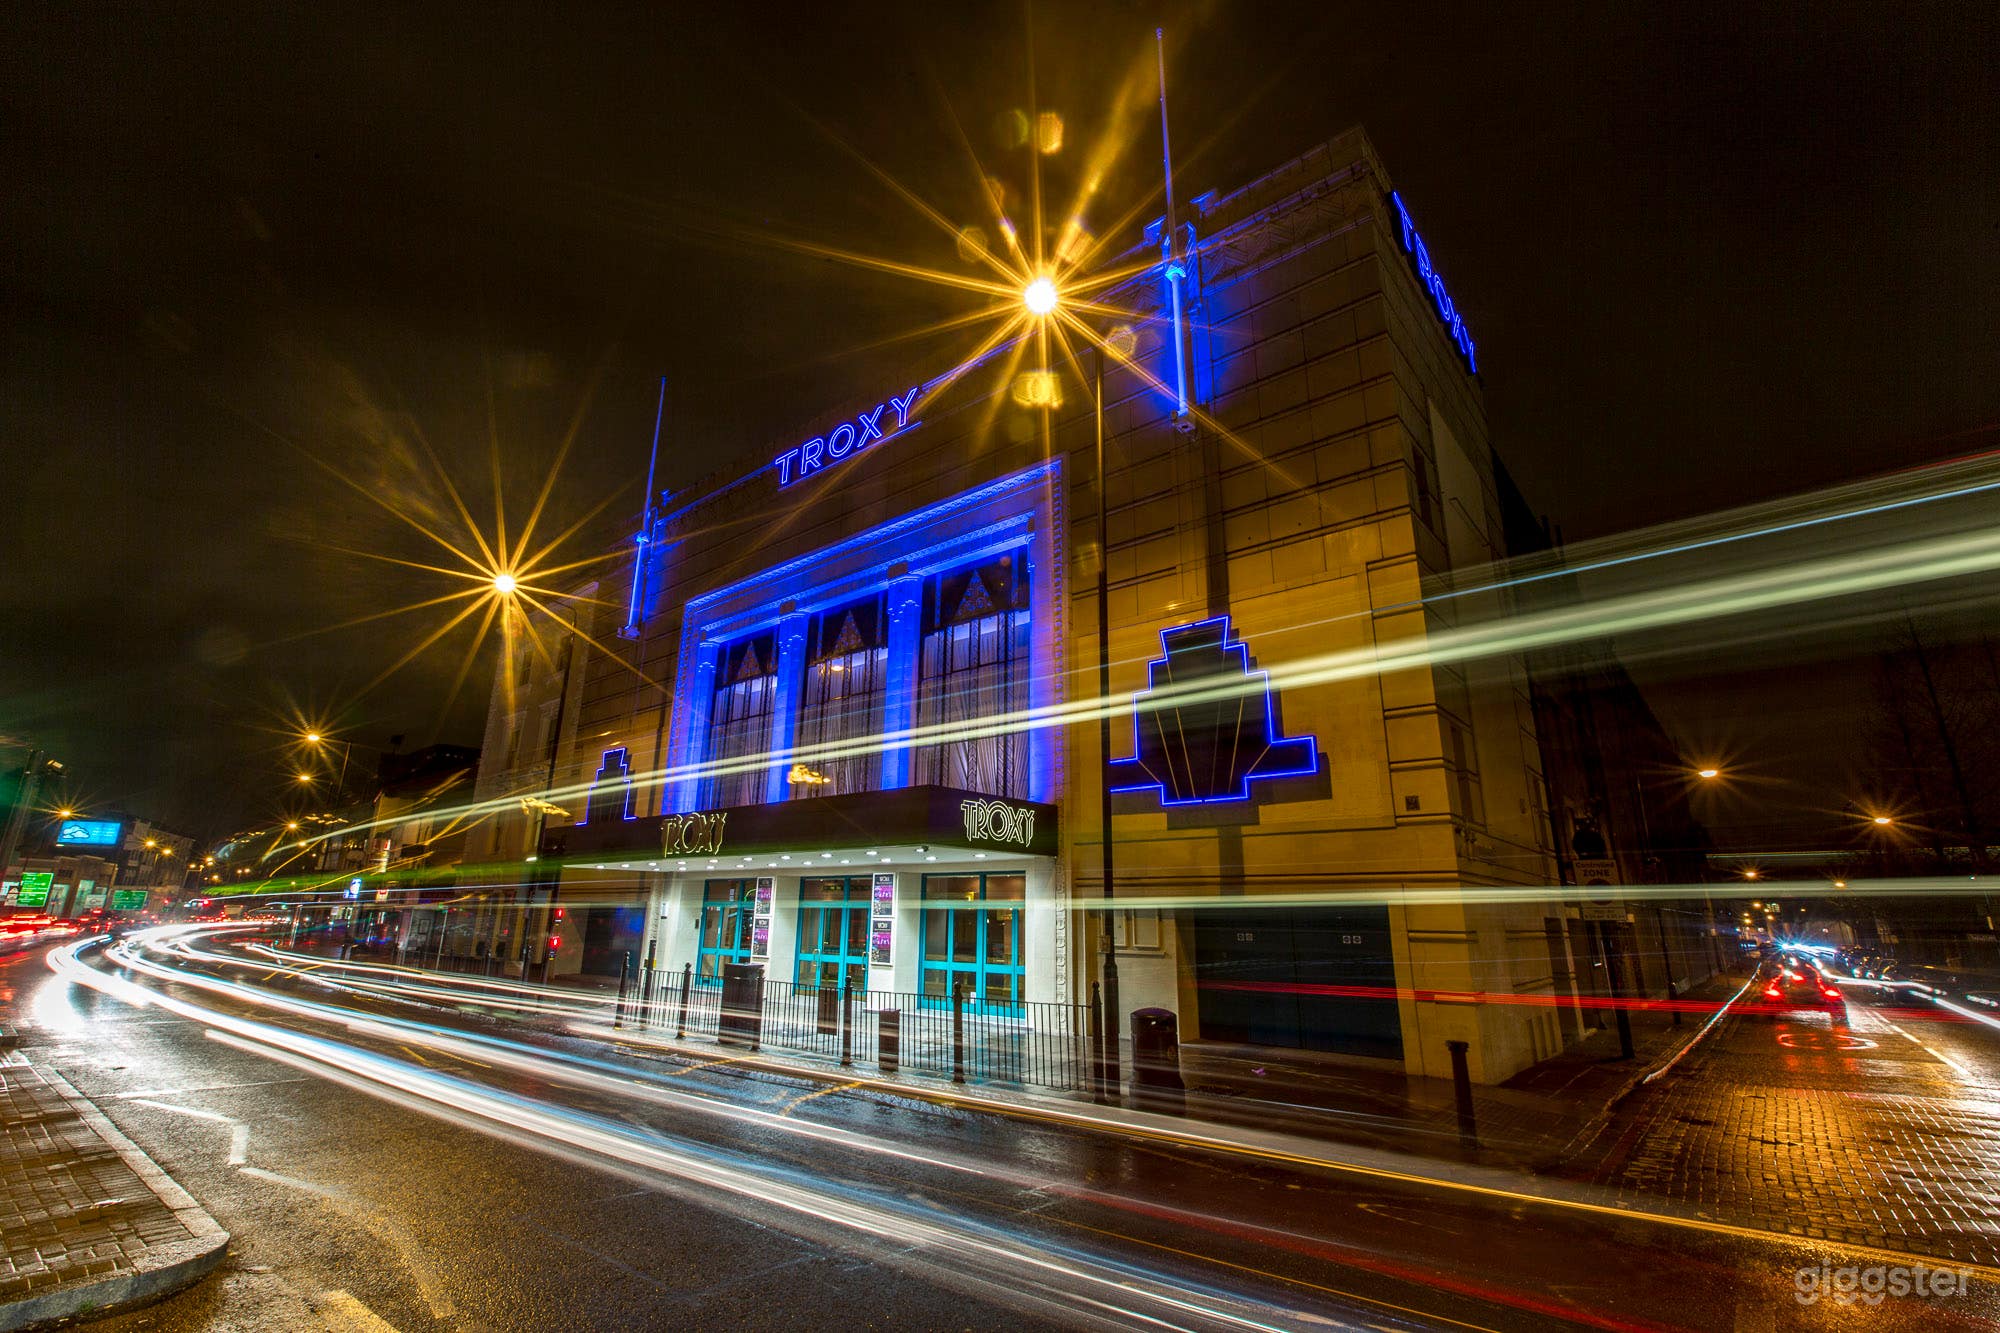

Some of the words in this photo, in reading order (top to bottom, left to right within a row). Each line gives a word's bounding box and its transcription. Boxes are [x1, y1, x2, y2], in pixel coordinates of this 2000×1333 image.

[1393, 190, 1476, 374] TROXY
[775, 387, 918, 485] TROXY
[660, 812, 728, 859] TROXY
[960, 798, 1036, 847] TROXY
[1583, 869, 1611, 877] ZONE
